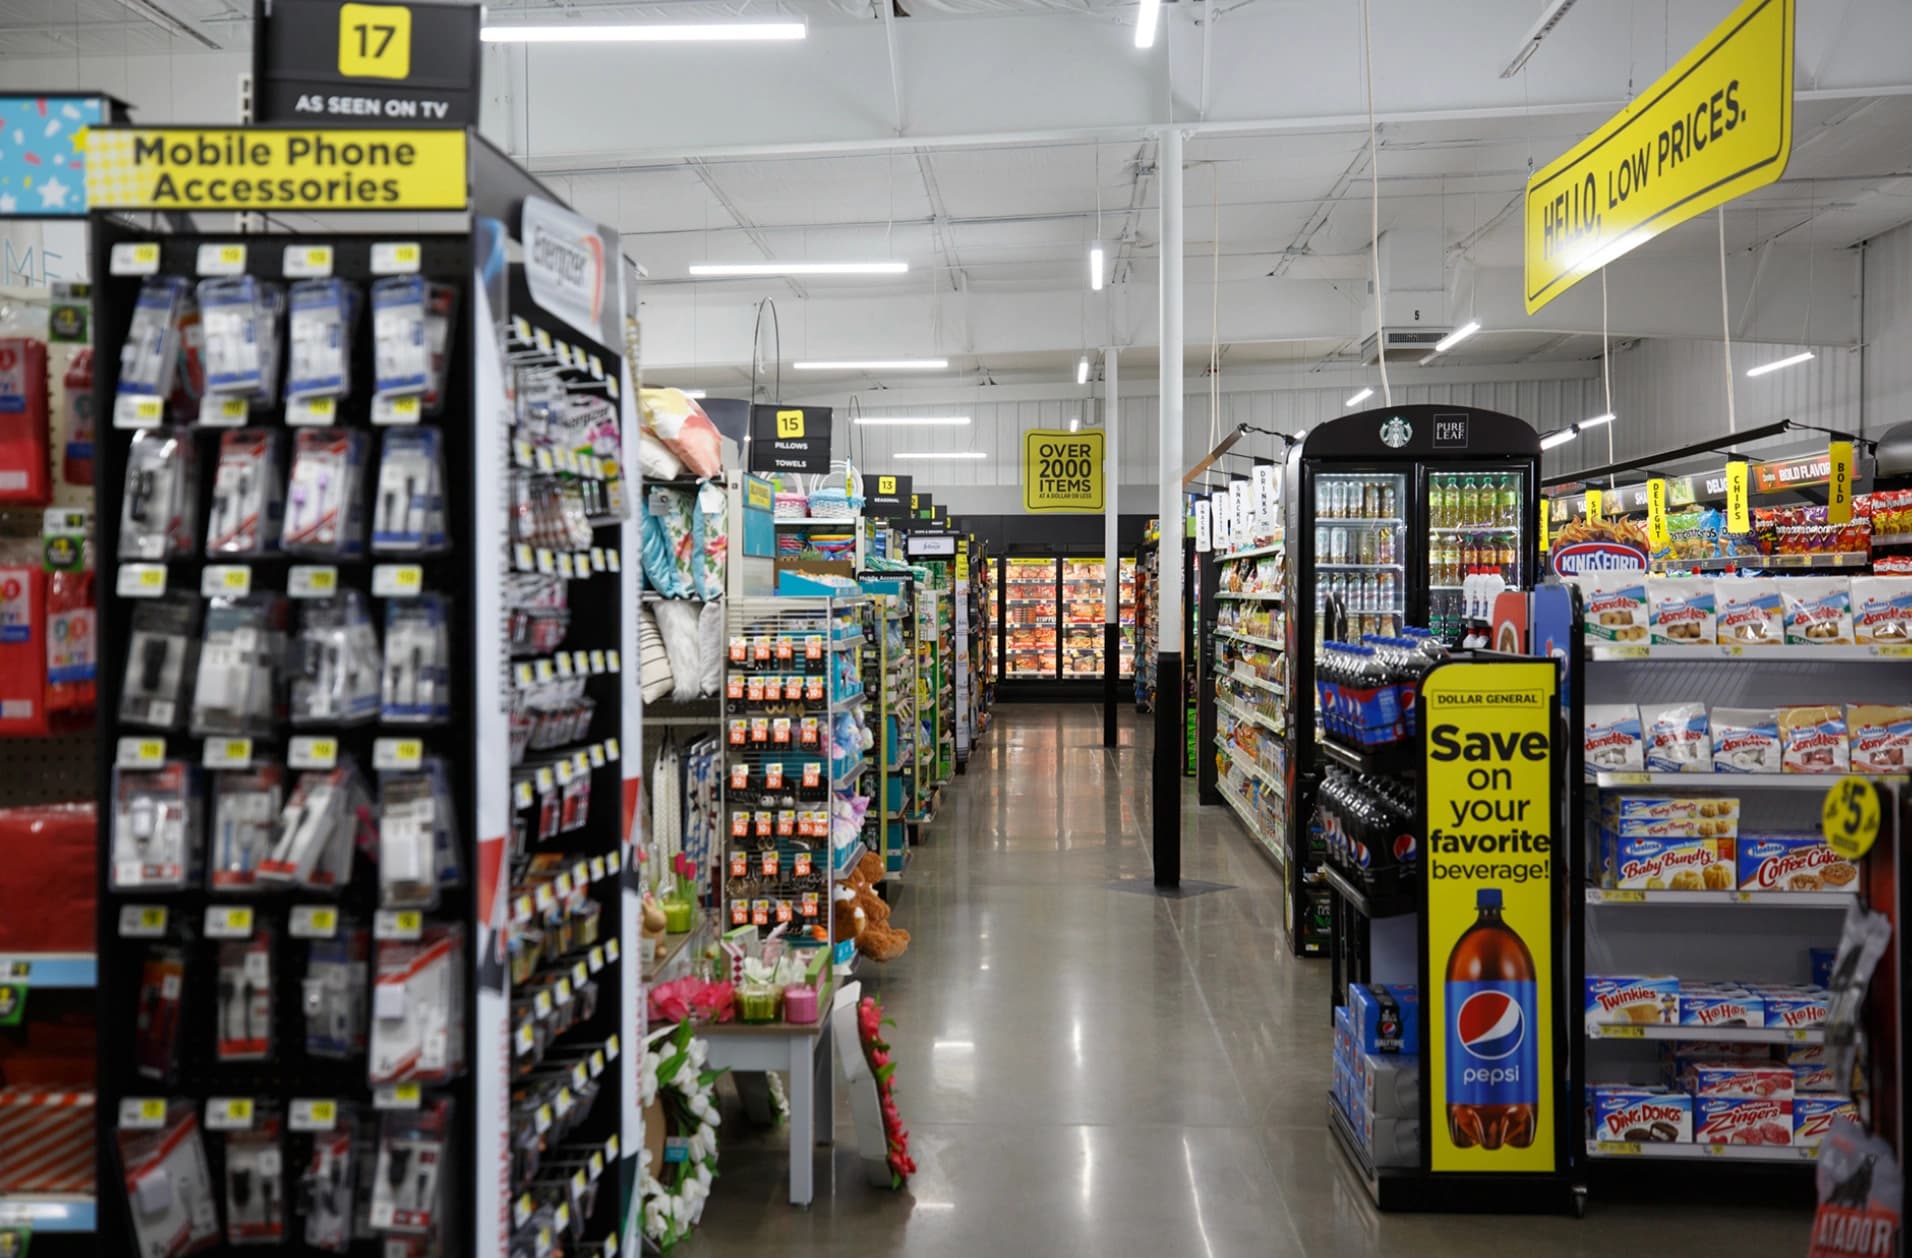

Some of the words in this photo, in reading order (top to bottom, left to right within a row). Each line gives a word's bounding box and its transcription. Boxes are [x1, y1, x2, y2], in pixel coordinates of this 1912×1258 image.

[353, 24, 396, 59] 17
[296, 95, 322, 111] AS
[328, 97, 379, 115] SEEN
[385, 100, 415, 117] ON
[421, 102, 448, 119] TV
[134, 136, 272, 168] Mobile
[286, 136, 416, 167] Phone
[1544, 172, 1602, 260] HELLO,
[1608, 142, 1651, 209] LOW
[1658, 80, 1746, 176] PRICES.
[153, 173, 400, 203] Accessories
[782, 417, 799, 431] 15
[1436, 422, 1465, 431] PURE
[1436, 431, 1465, 440] LEAF
[775, 442, 808, 450] PILLOWS
[1040, 444, 1091, 458] OVER
[776, 460, 807, 468] TOWELS
[1040, 459, 1092, 478] 2000
[882, 481, 893, 489] 13
[1040, 480, 1091, 492] ITEMS
[1260, 470, 1268, 515] DRINKS
[1837, 463, 1845, 503] BOLD
[1438, 694, 1482, 704] DOLLAR
[1487, 694, 1537, 704] GENERAL
[1430, 724, 1549, 762] Save
[1467, 768, 1512, 790] on
[1450, 800, 1530, 828] your
[1430, 829, 1550, 853] favorite
[1432, 860, 1549, 883] beverage!
[1623, 860, 1663, 879] Baby
[1662, 848, 1712, 866] Bundts
[1758, 855, 1807, 888] Coffee
[1597, 987, 1657, 1011] Twinkies
[1463, 1065, 1520, 1085] pepsi
[1642, 1104, 1682, 1121] DONGS
[1707, 1108, 1778, 1134] Zingers
